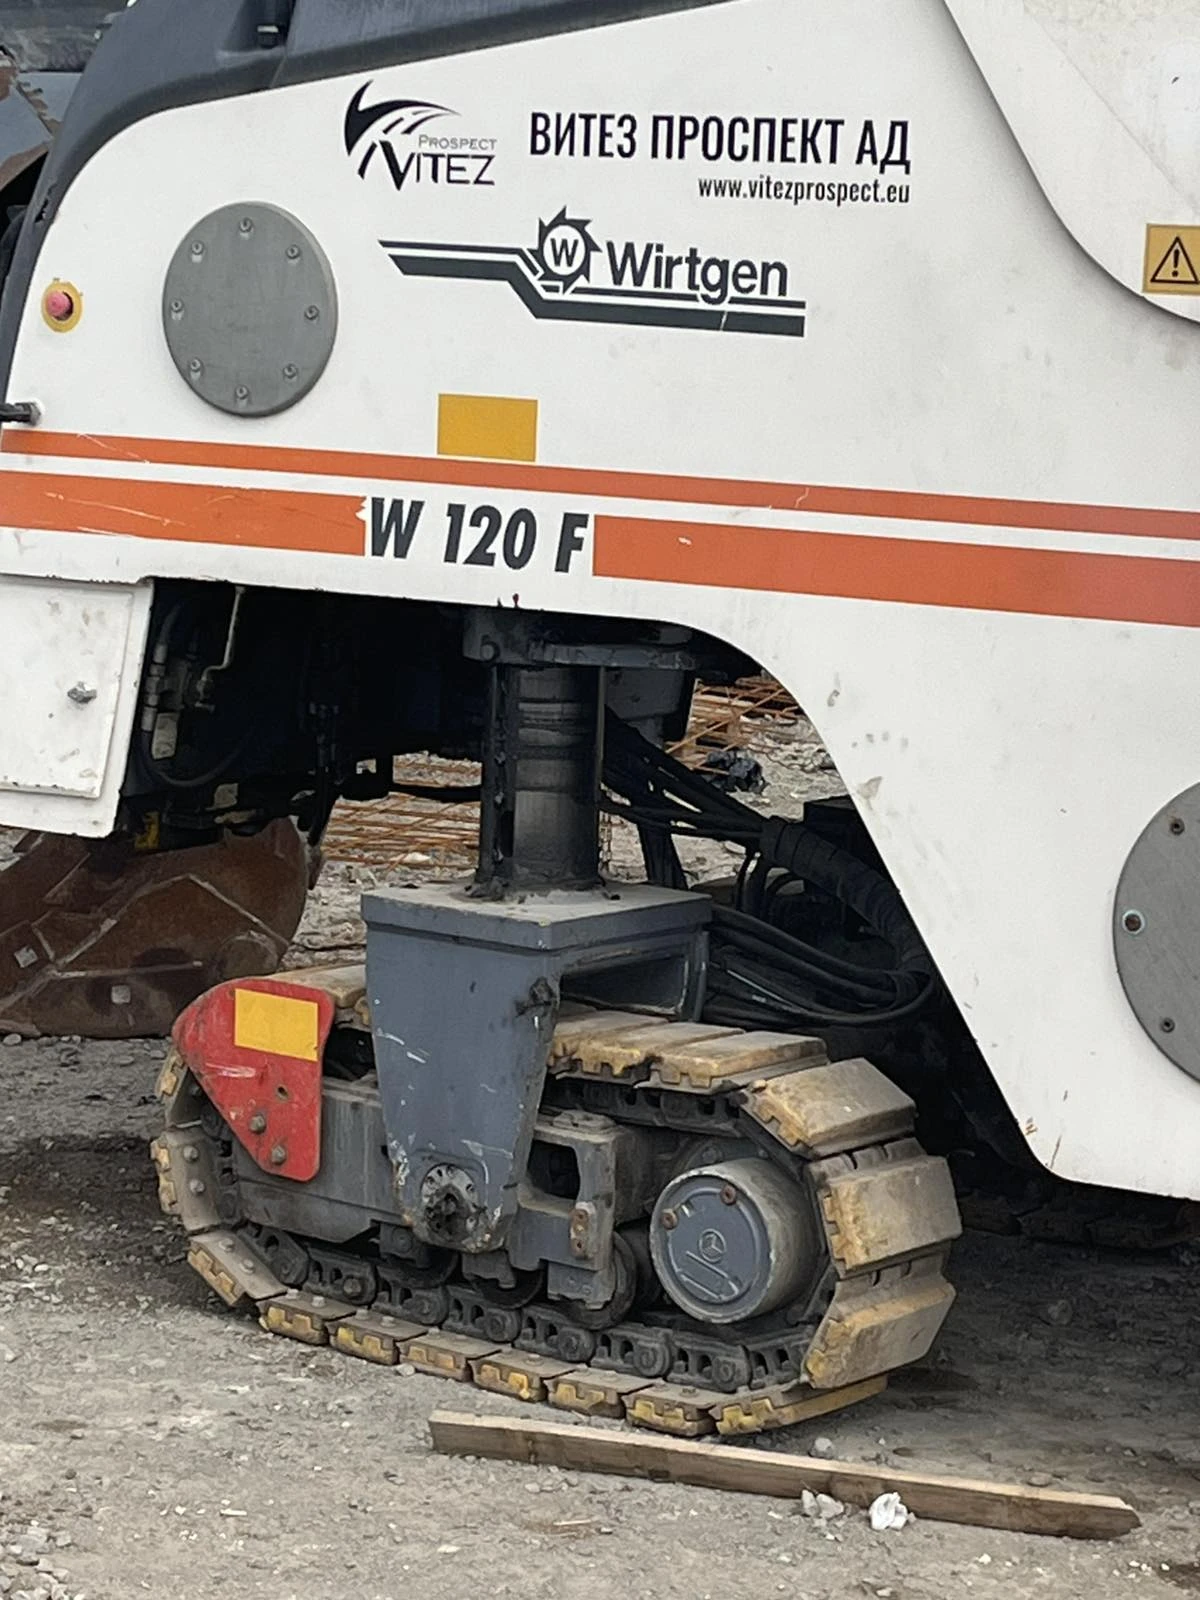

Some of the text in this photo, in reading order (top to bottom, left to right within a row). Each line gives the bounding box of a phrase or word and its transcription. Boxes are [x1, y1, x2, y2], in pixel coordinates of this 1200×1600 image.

[379, 140, 496, 191] VITEZ
[529, 111, 911, 174] ВИТЕЗ ПРОСПЕКТ АД
[698, 174, 911, 206] www.vitezprospect.eu
[550, 237, 788, 303] W Wirtgen
[371, 496, 589, 573] W 120 F
